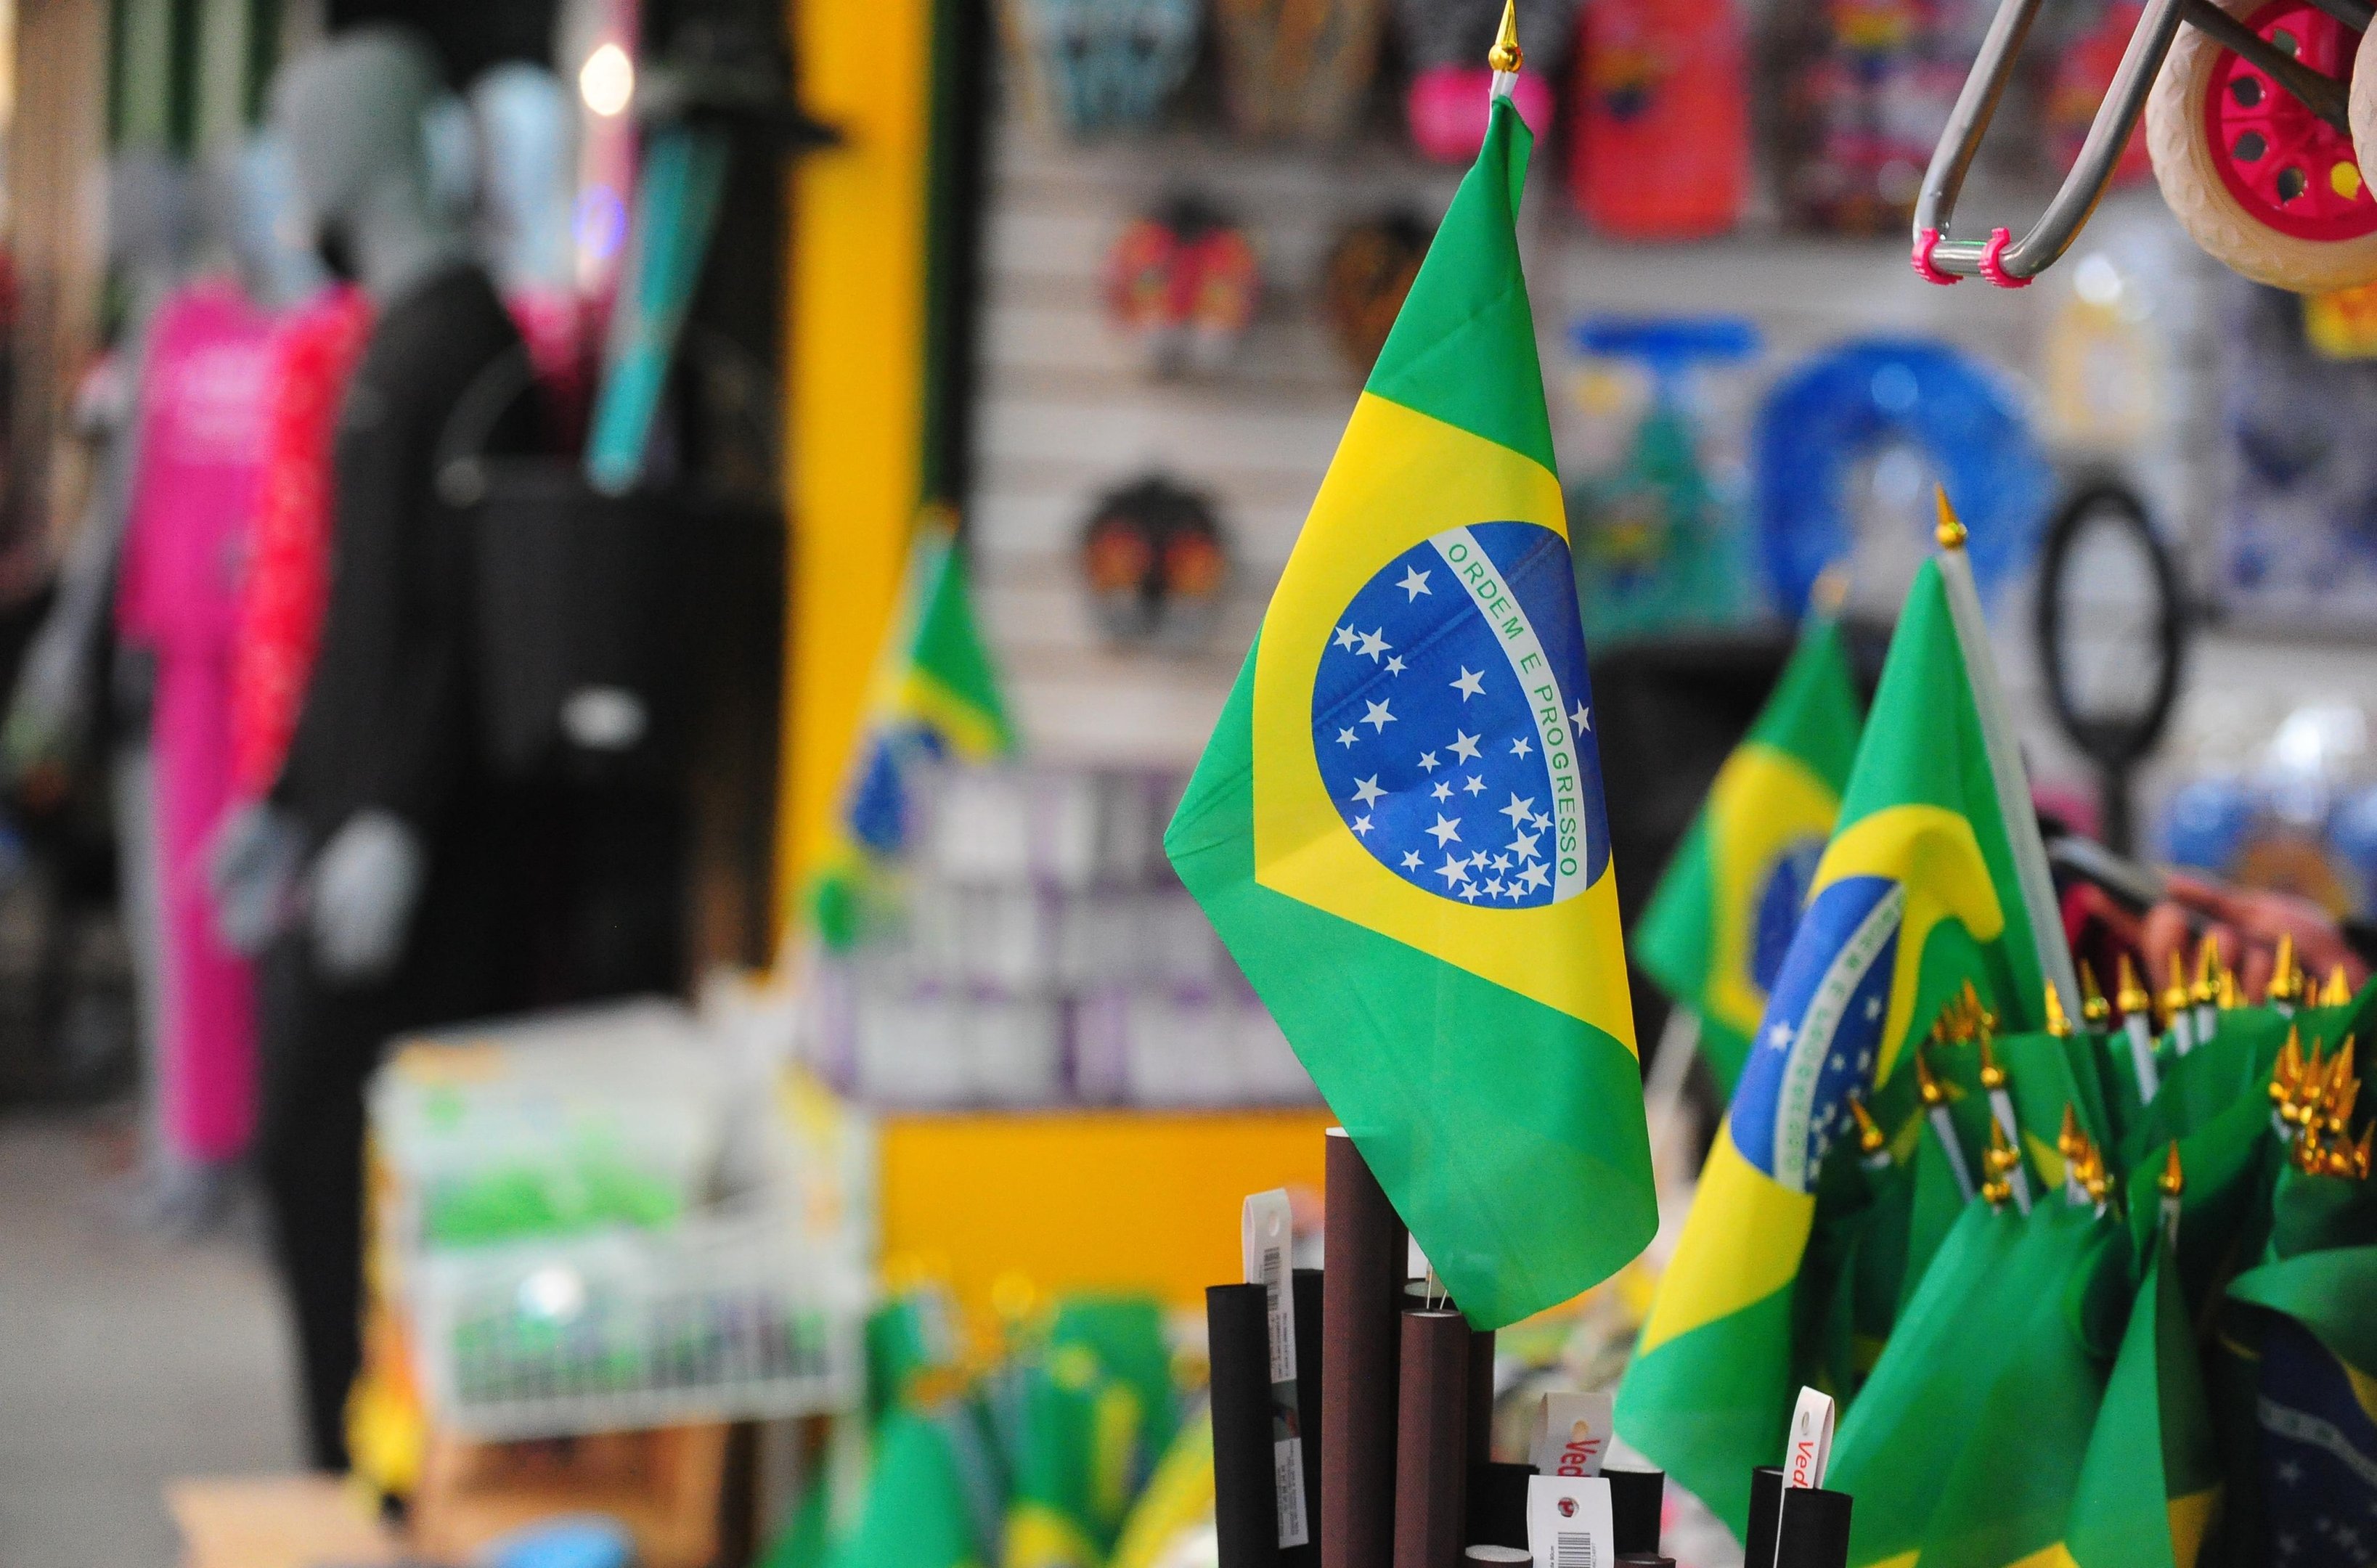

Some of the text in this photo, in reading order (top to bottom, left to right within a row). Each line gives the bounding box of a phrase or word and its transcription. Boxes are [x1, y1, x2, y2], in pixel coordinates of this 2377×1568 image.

[1448, 542, 1578, 878] ORDEM E PROGRESSO
